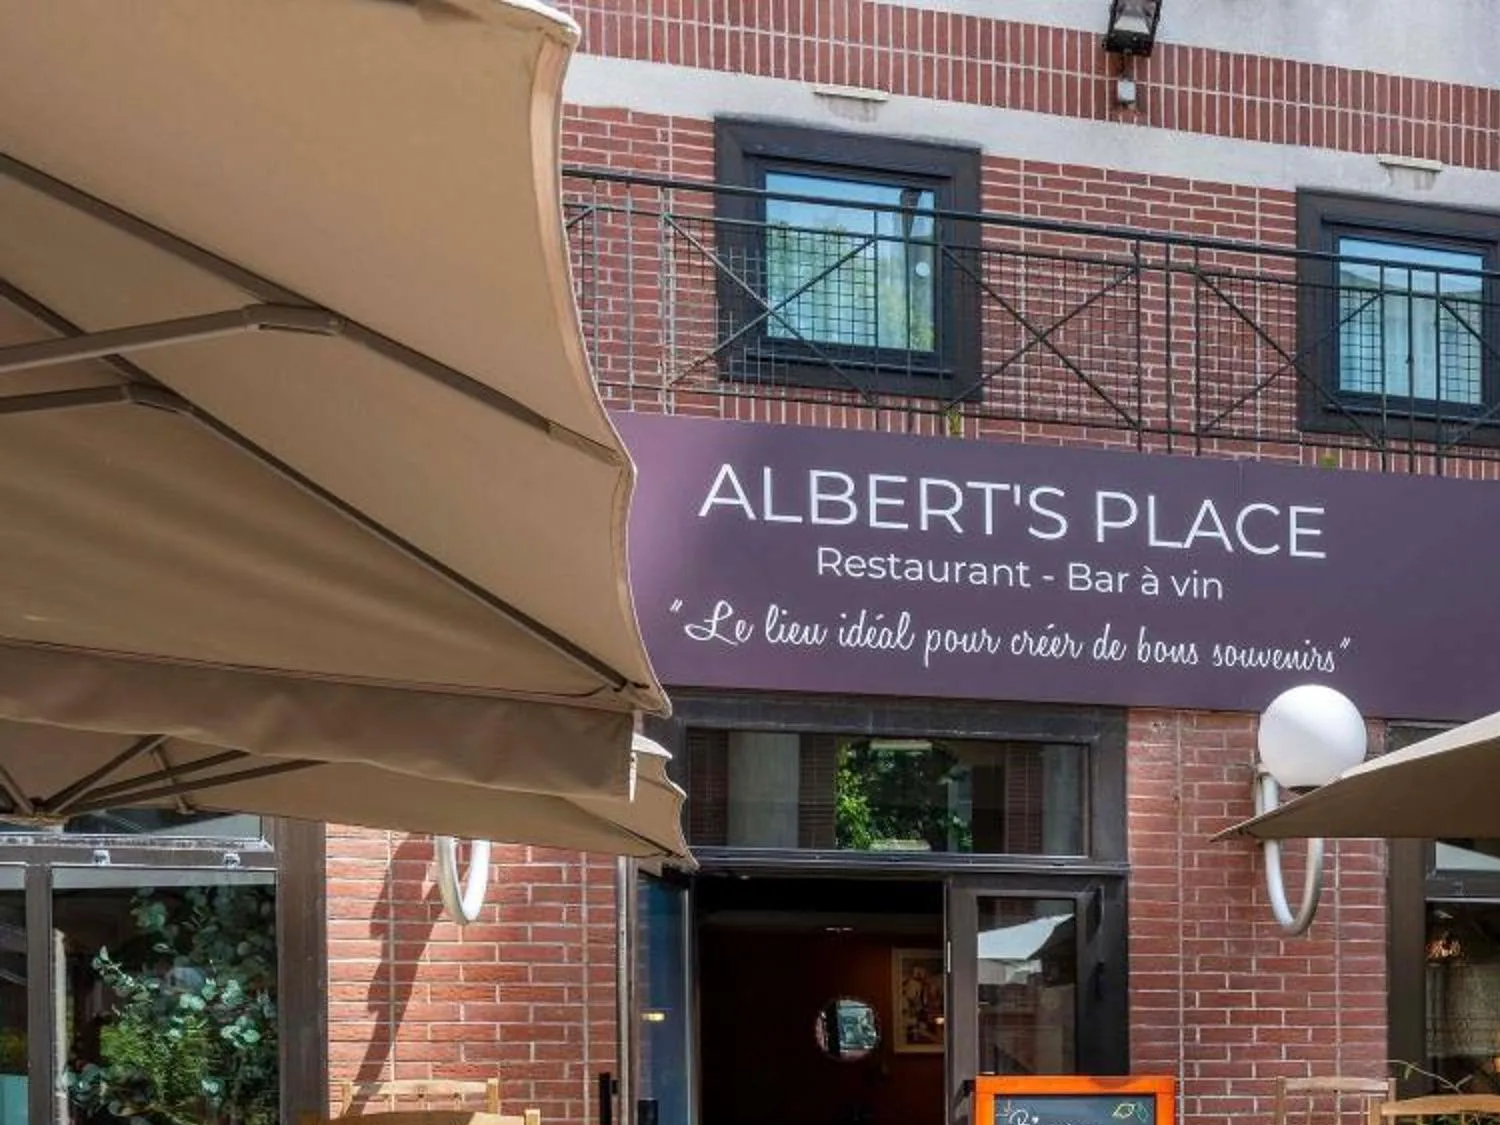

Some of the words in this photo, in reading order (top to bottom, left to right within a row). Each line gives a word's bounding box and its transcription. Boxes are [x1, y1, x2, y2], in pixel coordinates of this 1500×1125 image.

[697, 463, 1069, 541] ALBERT'S
[1095, 489, 1327, 560] PLACE
[816, 545, 1032, 589] Restaurant
[1067, 561, 1131, 594] Bar
[1140, 565, 1160, 597] à
[1169, 568, 1224, 601] vin
[764, 603, 829, 646] lieu
[837, 608, 916, 651] idéal
[923, 627, 1002, 669] pour
[1009, 623, 1086, 660] créer
[1091, 622, 1128, 662] de
[1136, 625, 1200, 666] bons
